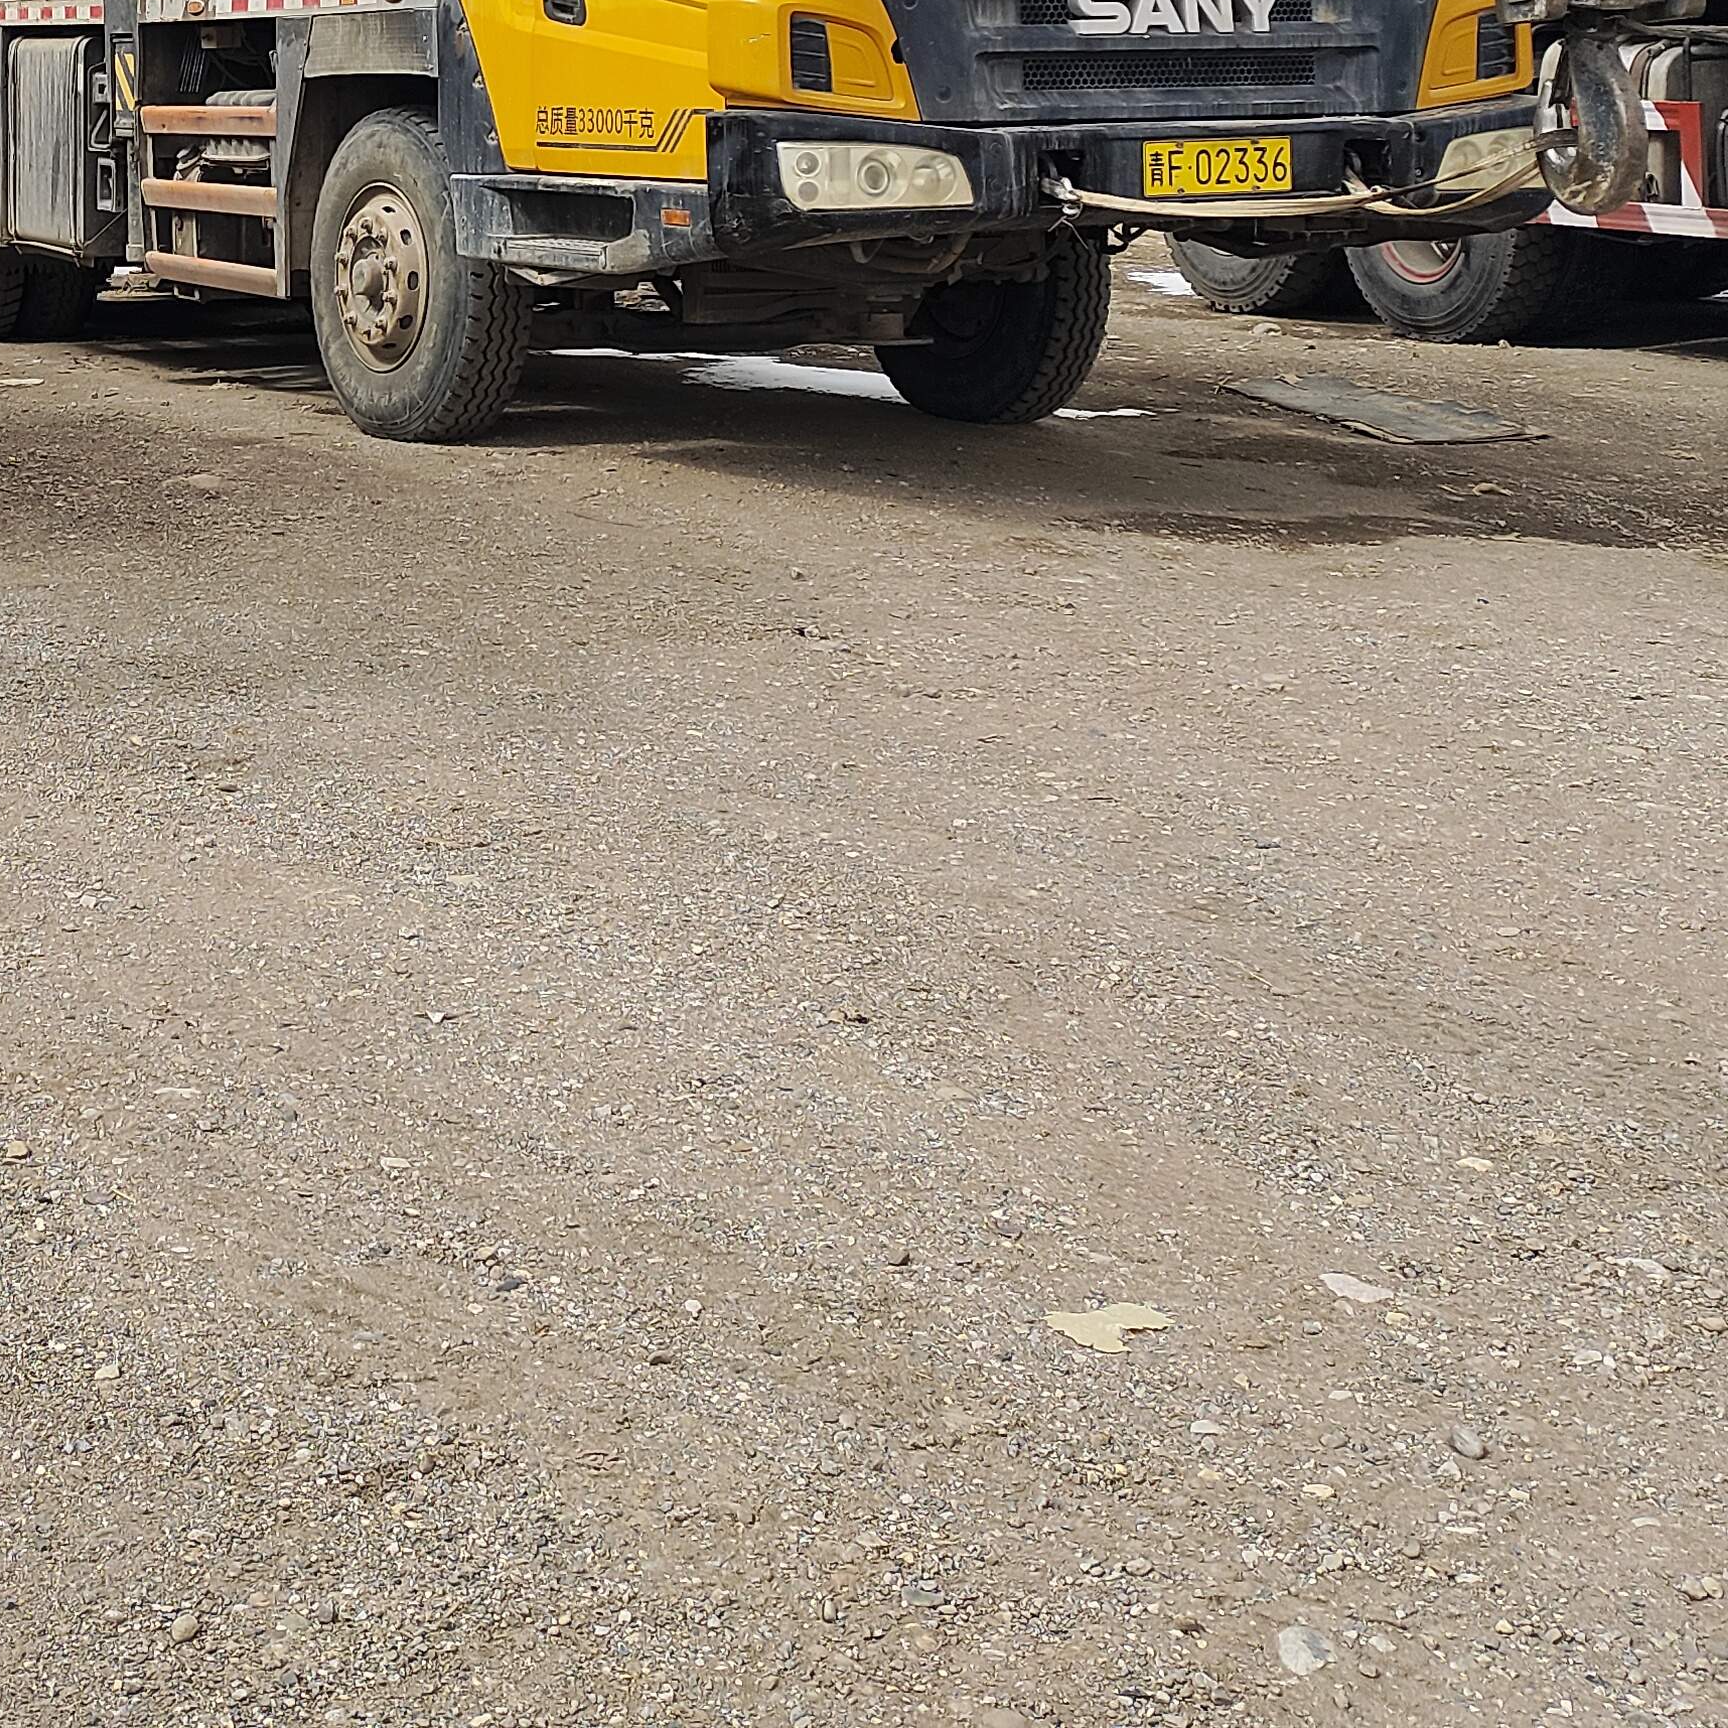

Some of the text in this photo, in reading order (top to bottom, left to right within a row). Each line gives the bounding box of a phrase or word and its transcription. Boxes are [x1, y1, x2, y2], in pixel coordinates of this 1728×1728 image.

[535, 106, 656, 139] 总质量33000千克
